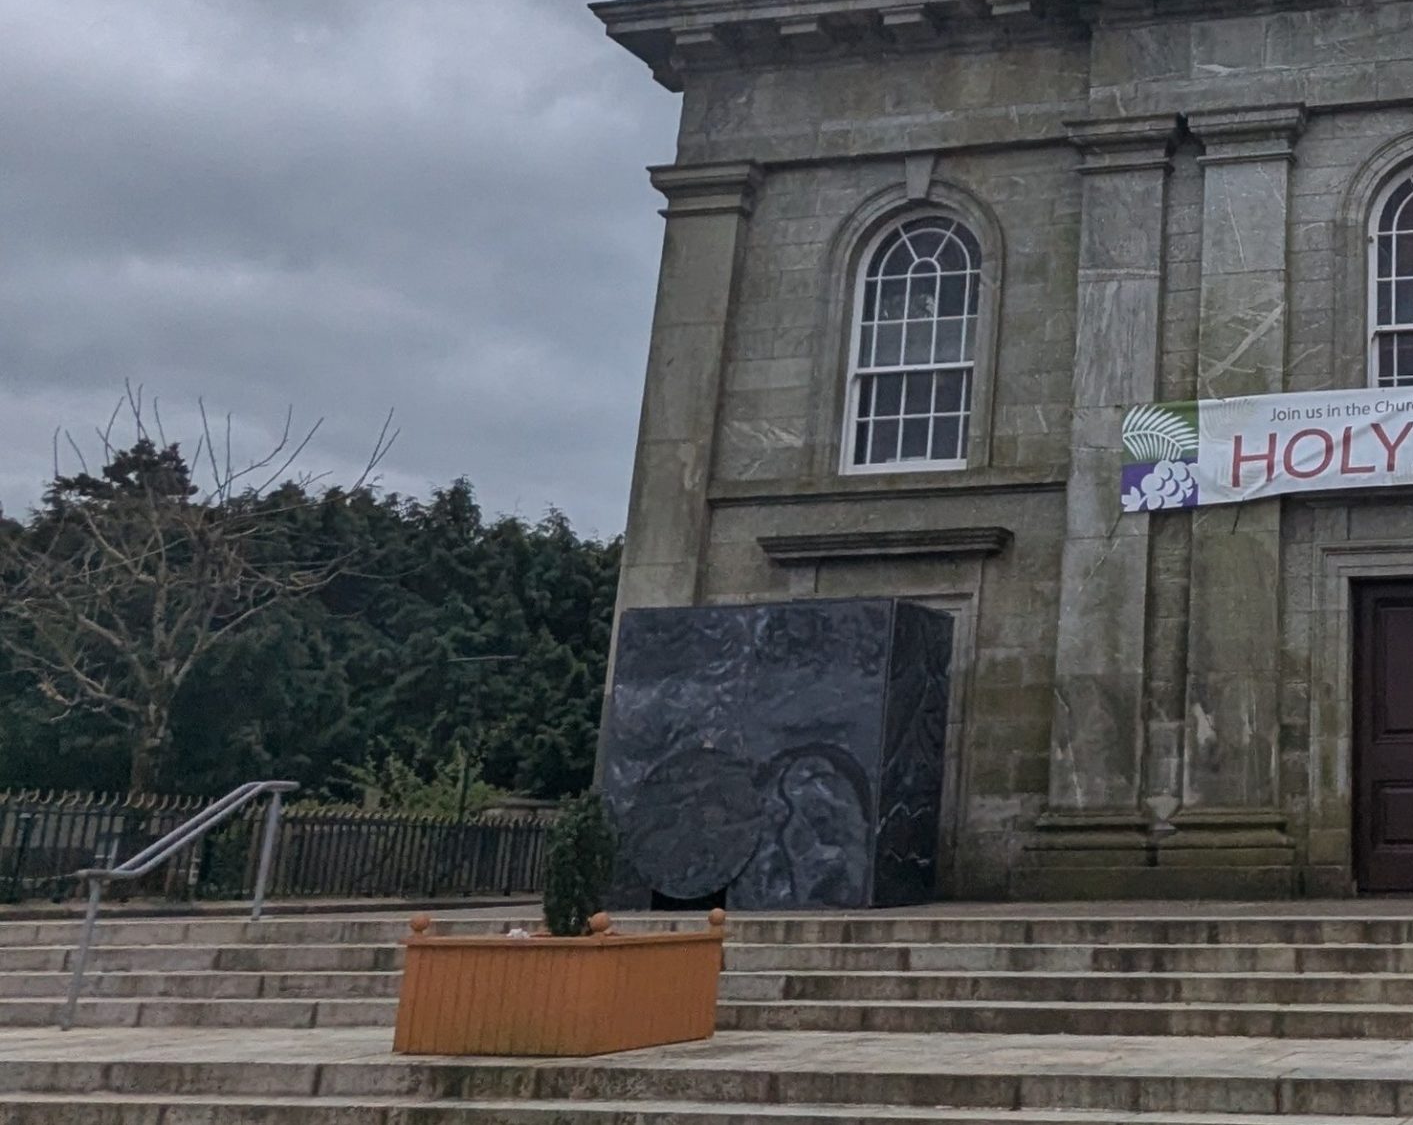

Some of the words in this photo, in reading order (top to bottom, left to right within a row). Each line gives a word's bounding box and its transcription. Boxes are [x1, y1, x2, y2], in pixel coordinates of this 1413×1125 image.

[1270, 407, 1300, 422] Join
[1306, 407, 1323, 419] us
[1327, 404, 1341, 418] in
[1346, 403, 1370, 416] the
